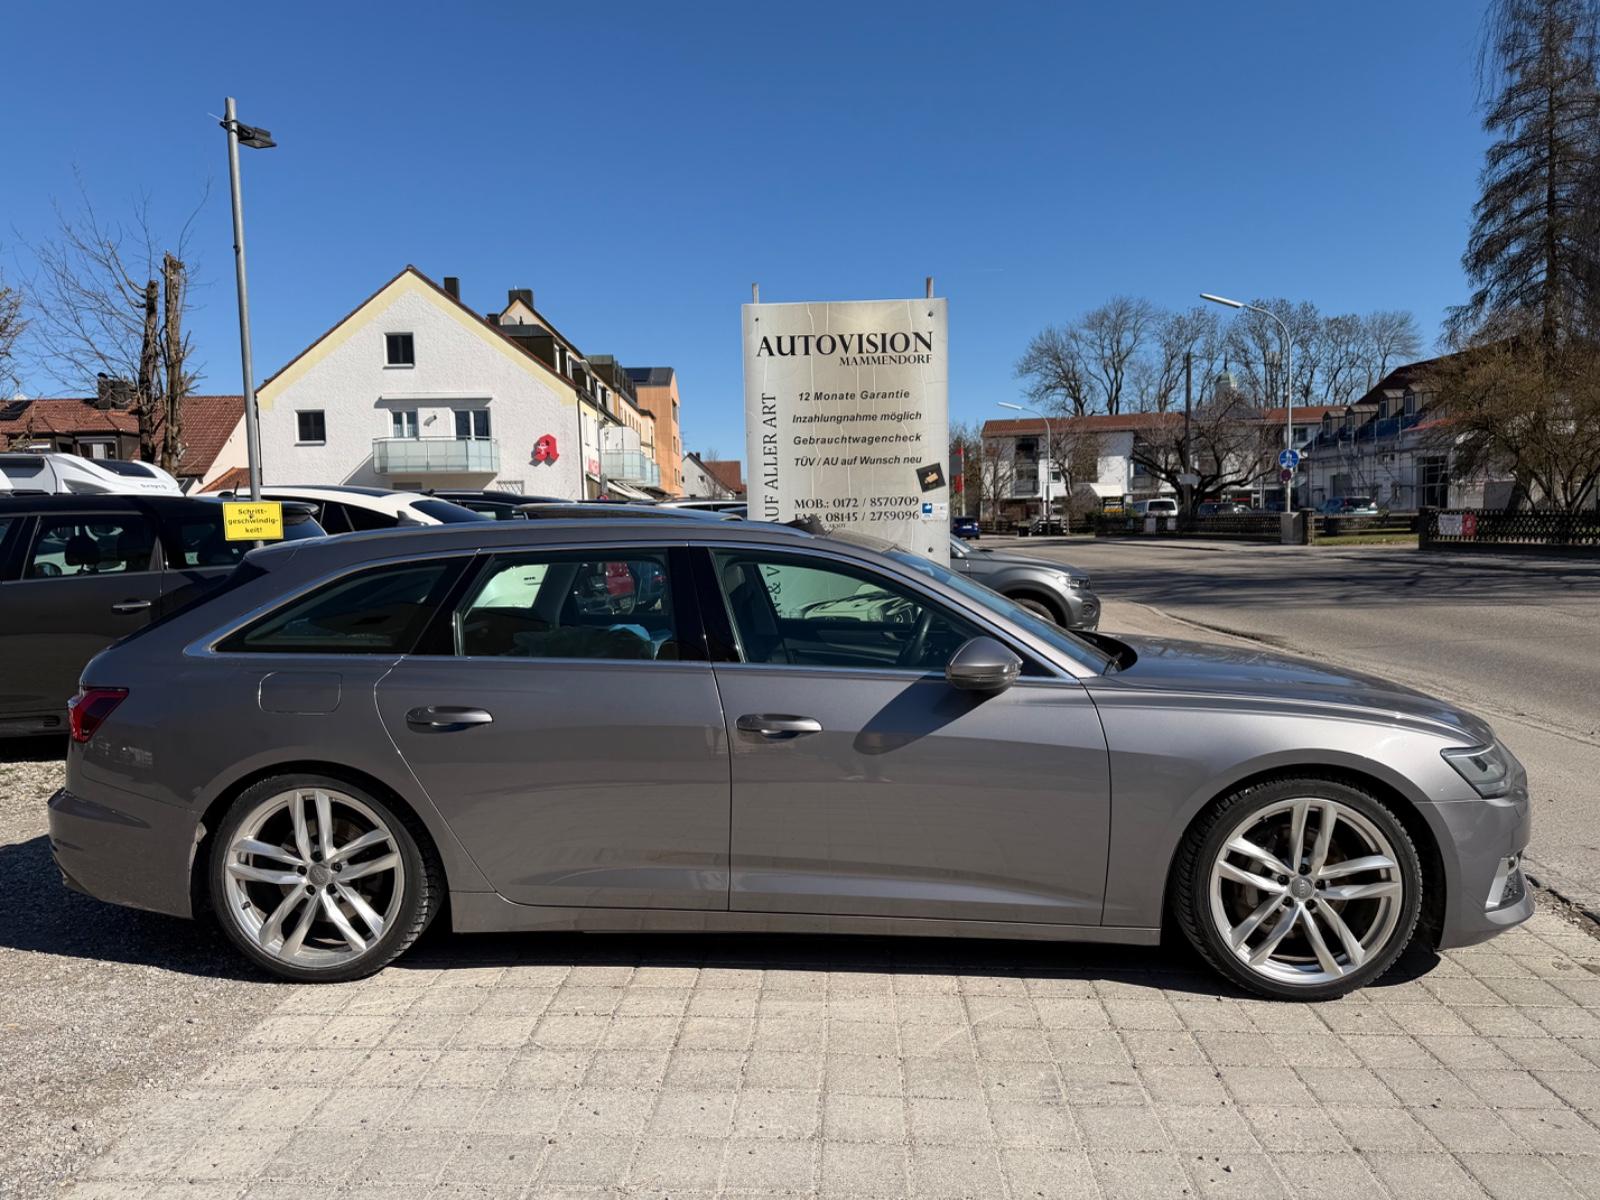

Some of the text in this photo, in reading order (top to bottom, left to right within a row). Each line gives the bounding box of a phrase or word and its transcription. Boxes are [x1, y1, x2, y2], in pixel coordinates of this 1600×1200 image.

[756, 331, 933, 357] AUTOVISION
[839, 354, 932, 366] MAMMENDORF
[798, 389, 910, 401] 12 Monate Garantie
[761, 393, 777, 428] ART
[792, 411, 922, 425] Inzahlungnahme möglich
[793, 433, 922, 446] Gebrauchtwagencheck
[763, 433, 779, 490] ALLER
[794, 456, 816, 467] TÜV
[823, 457, 839, 466] AU
[840, 456, 857, 466] auf
[859, 455, 901, 466] Wunsch
[903, 456, 922, 464] neu
[794, 499, 829, 509] MOB.:
[832, 498, 859, 508] 0172
[870, 496, 919, 507] 8570709
[228, 517, 279, 526] geschwindig-
[825, 512, 858, 522] 08145
[870, 510, 920, 521] 2759096
